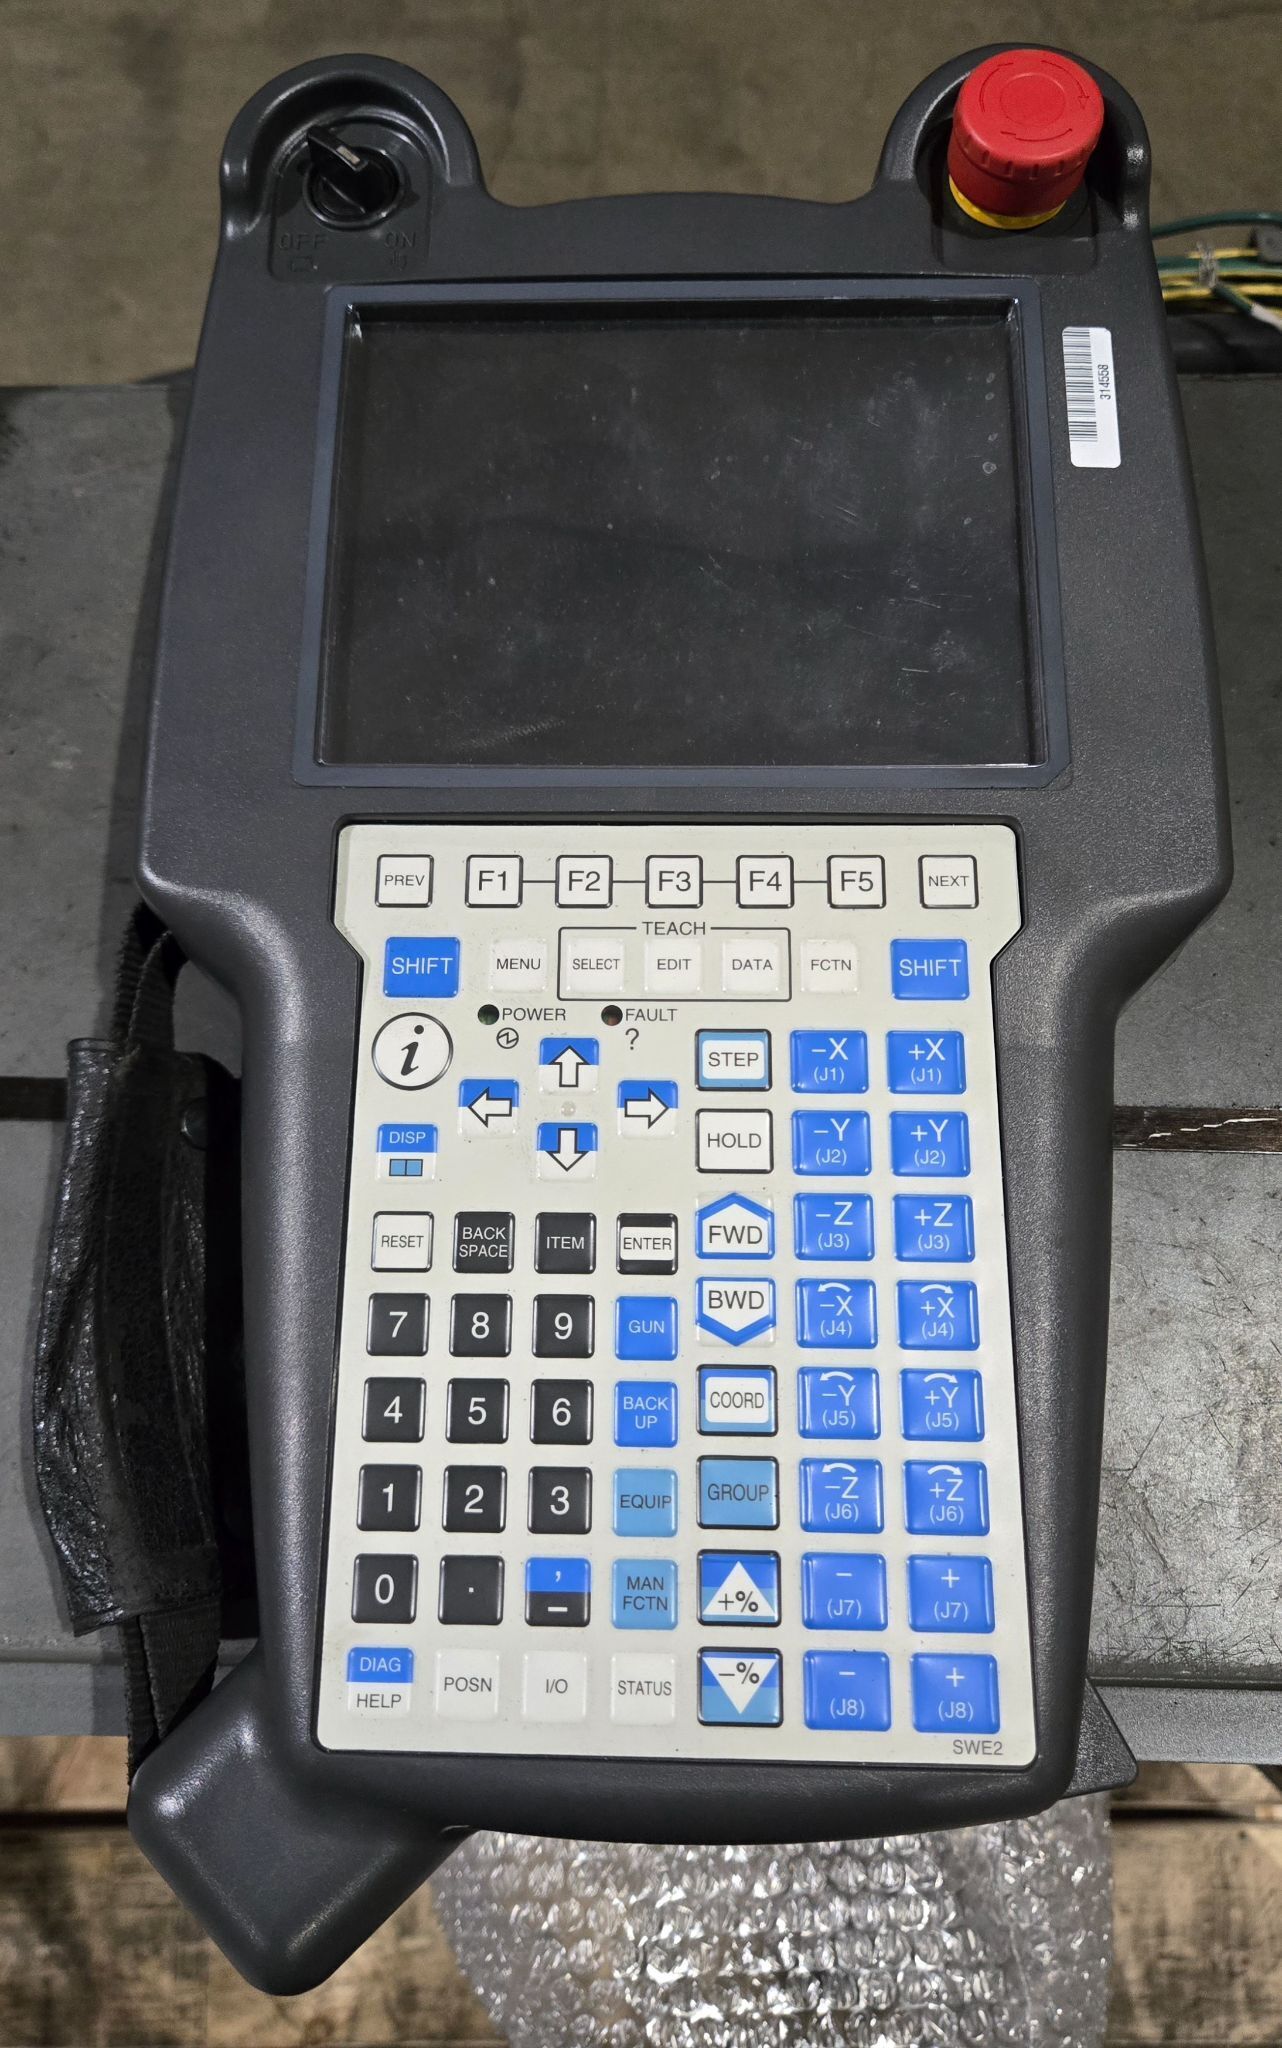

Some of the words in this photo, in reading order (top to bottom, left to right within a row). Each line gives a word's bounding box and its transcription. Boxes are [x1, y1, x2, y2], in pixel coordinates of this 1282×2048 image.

[280, 233, 327, 250] OFF
[384, 231, 417, 249] ON
[1098, 364, 1111, 400] 314558
[384, 874, 425, 887] PREV
[478, 870, 508, 891] F1
[568, 870, 601, 891] F2
[658, 871, 691, 891] F3
[749, 870, 782, 892] F4
[840, 871, 874, 892] F5
[928, 875, 970, 887] NEXT
[642, 921, 706, 935] TEACH
[392, 957, 453, 975] SHIFT
[496, 958, 541, 970] MENU
[572, 958, 621, 970] SELECT
[657, 958, 692, 970] EDIT
[731, 959, 773, 971] DATA
[811, 959, 852, 971] FCTN
[899, 959, 962, 977] SHIFT
[502, 1008, 566, 1021] POWER
[625, 1008, 677, 1021] FAULT
[625, 1028, 639, 1050] ?
[811, 1037, 848, 1060] -X
[909, 1038, 946, 1061] +X
[708, 1052, 759, 1067] STEP
[813, 1068, 845, 1083] (J1)
[910, 1068, 942, 1083] (J1)
[389, 1131, 426, 1144] DISP
[814, 1118, 850, 1142] -Y
[910, 1119, 949, 1142] +Y
[707, 1133, 762, 1148] HOLD
[815, 1150, 847, 1165] (J2)
[914, 1150, 946, 1166] (J2)
[816, 1201, 853, 1226] -Z
[914, 1203, 953, 1227] +Z
[381, 1235, 424, 1248] RESET
[462, 1227, 506, 1241] BACK
[546, 1236, 585, 1250] ITEM
[709, 1225, 763, 1244] FWD
[817, 1233, 850, 1250] (J3)
[918, 1234, 950, 1251] (J3)
[459, 1244, 508, 1258] SPACE
[623, 1238, 672, 1251] ENTER
[708, 1290, 765, 1310] BWD
[819, 1295, 853, 1317] -X
[920, 1297, 955, 1319] +X
[389, 1311, 408, 1338] 7
[471, 1311, 490, 1339] 8
[554, 1312, 573, 1340] 9
[628, 1320, 665, 1334] GUN
[820, 1320, 852, 1338] (J4)
[921, 1322, 954, 1339] (J4)
[623, 1396, 669, 1410] BACK
[710, 1391, 765, 1409] COORD
[822, 1384, 856, 1407] -Y
[924, 1386, 959, 1408] +Y
[383, 1395, 403, 1424] 4
[467, 1397, 487, 1425] 5
[552, 1398, 572, 1426] 6
[634, 1416, 657, 1430] UP
[822, 1410, 856, 1429] (J5)
[925, 1412, 959, 1430] (J5)
[707, 1483, 769, 1502] GROUP
[825, 1476, 859, 1499] -Z
[929, 1478, 964, 1501] +Z
[382, 1483, 394, 1513] 1
[464, 1485, 484, 1514] 2
[550, 1485, 570, 1515] 3
[620, 1494, 672, 1509] EQUIP
[825, 1503, 859, 1521] (J6)
[929, 1505, 964, 1523] (J6)
[627, 1576, 664, 1590] MAN
[940, 1568, 960, 1588] +
[374, 1573, 395, 1605] 0
[623, 1595, 668, 1611] FCTN
[718, 1590, 759, 1613] +%
[827, 1599, 862, 1619] (J7)
[934, 1600, 969, 1621] (J7)
[359, 1657, 401, 1672] DIAG
[718, 1661, 760, 1684] -%
[444, 1676, 492, 1692] POSN
[545, 1678, 568, 1694] I/O
[946, 1667, 965, 1687] +
[617, 1680, 672, 1696] STATUS
[356, 1694, 402, 1709] HELP
[830, 1699, 865, 1719] (J8)
[938, 1701, 974, 1722] (J8)
[953, 1740, 1003, 1756] SWE2
